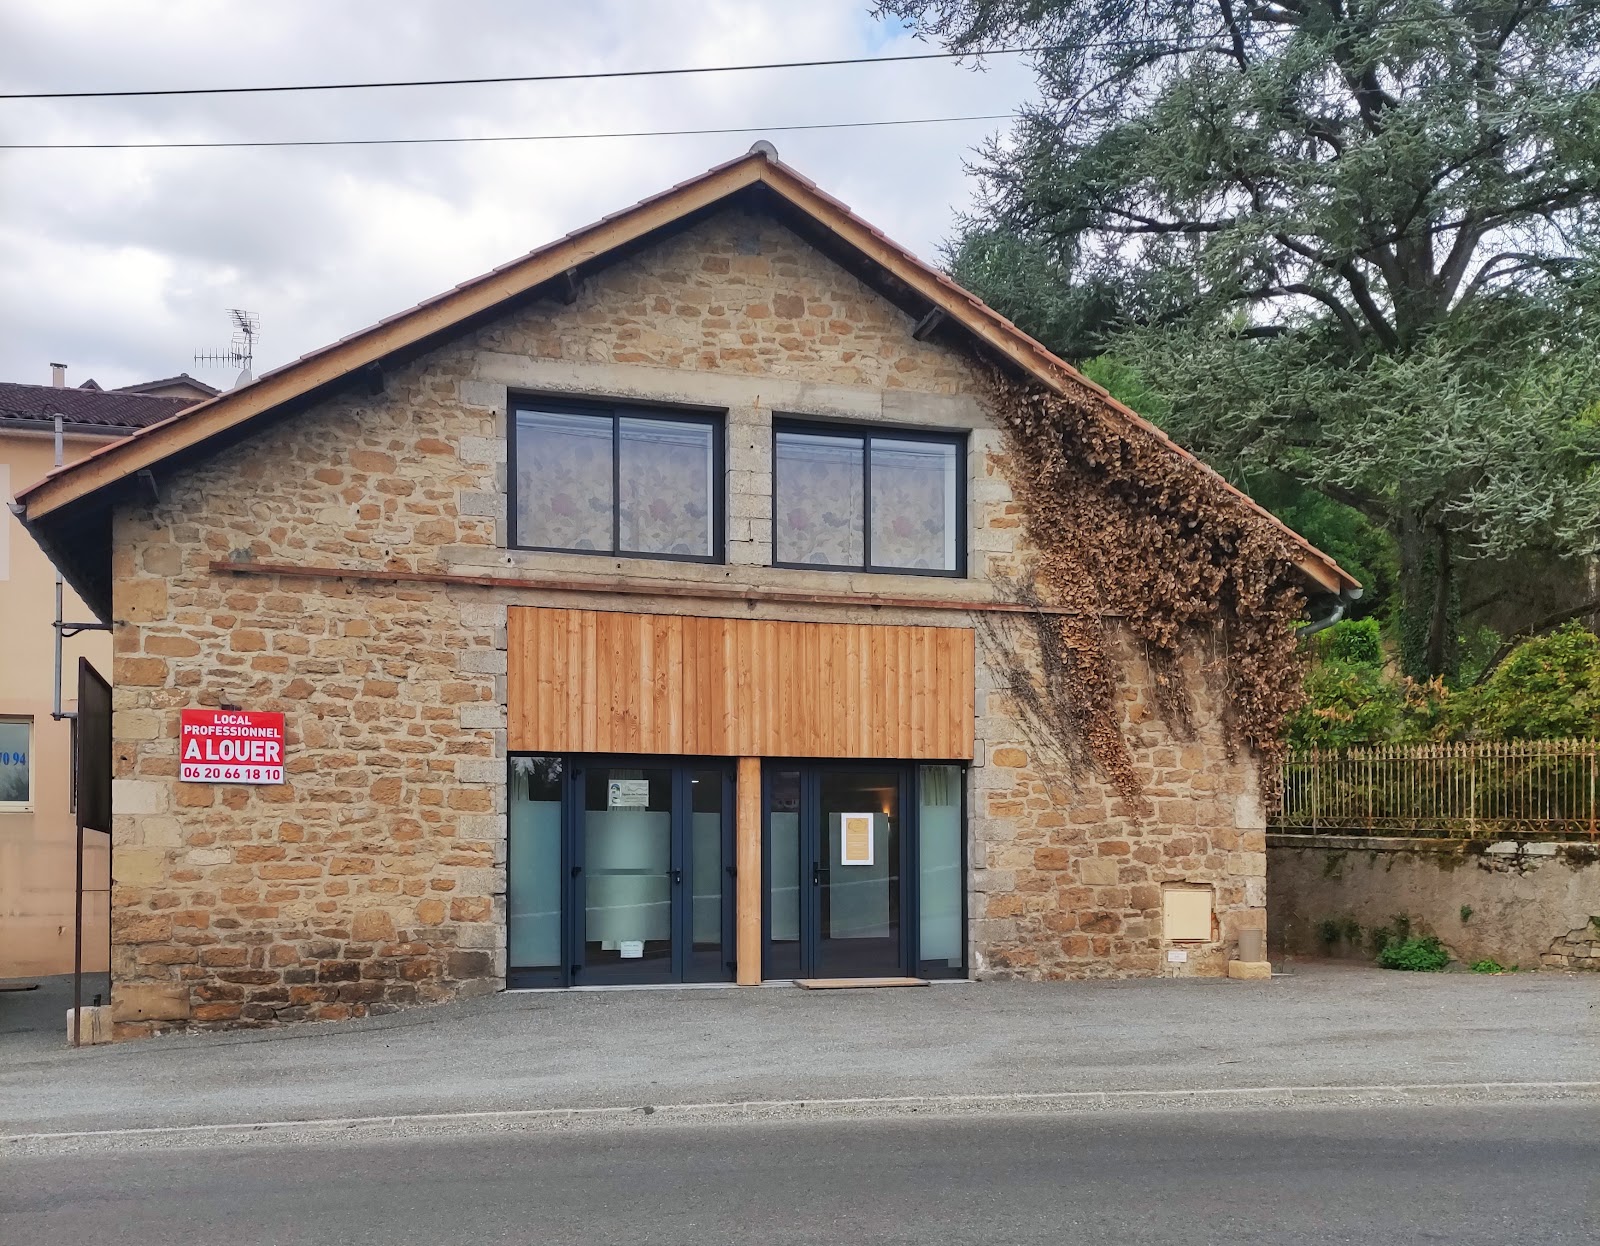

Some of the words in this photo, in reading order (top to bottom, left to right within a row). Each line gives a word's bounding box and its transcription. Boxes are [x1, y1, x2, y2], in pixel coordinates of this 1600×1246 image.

[214, 714, 252, 725] LOCAL
[184, 725, 281, 738] PROFESSIONNEL
[184, 738, 202, 760] A
[206, 739, 280, 762] LOUER
[13, 752, 26, 766] 94
[184, 767, 200, 778] 06
[205, 768, 220, 778] 20
[225, 768, 240, 779] 66
[245, 769, 260, 779] 18
[265, 769, 280, 780] 10
